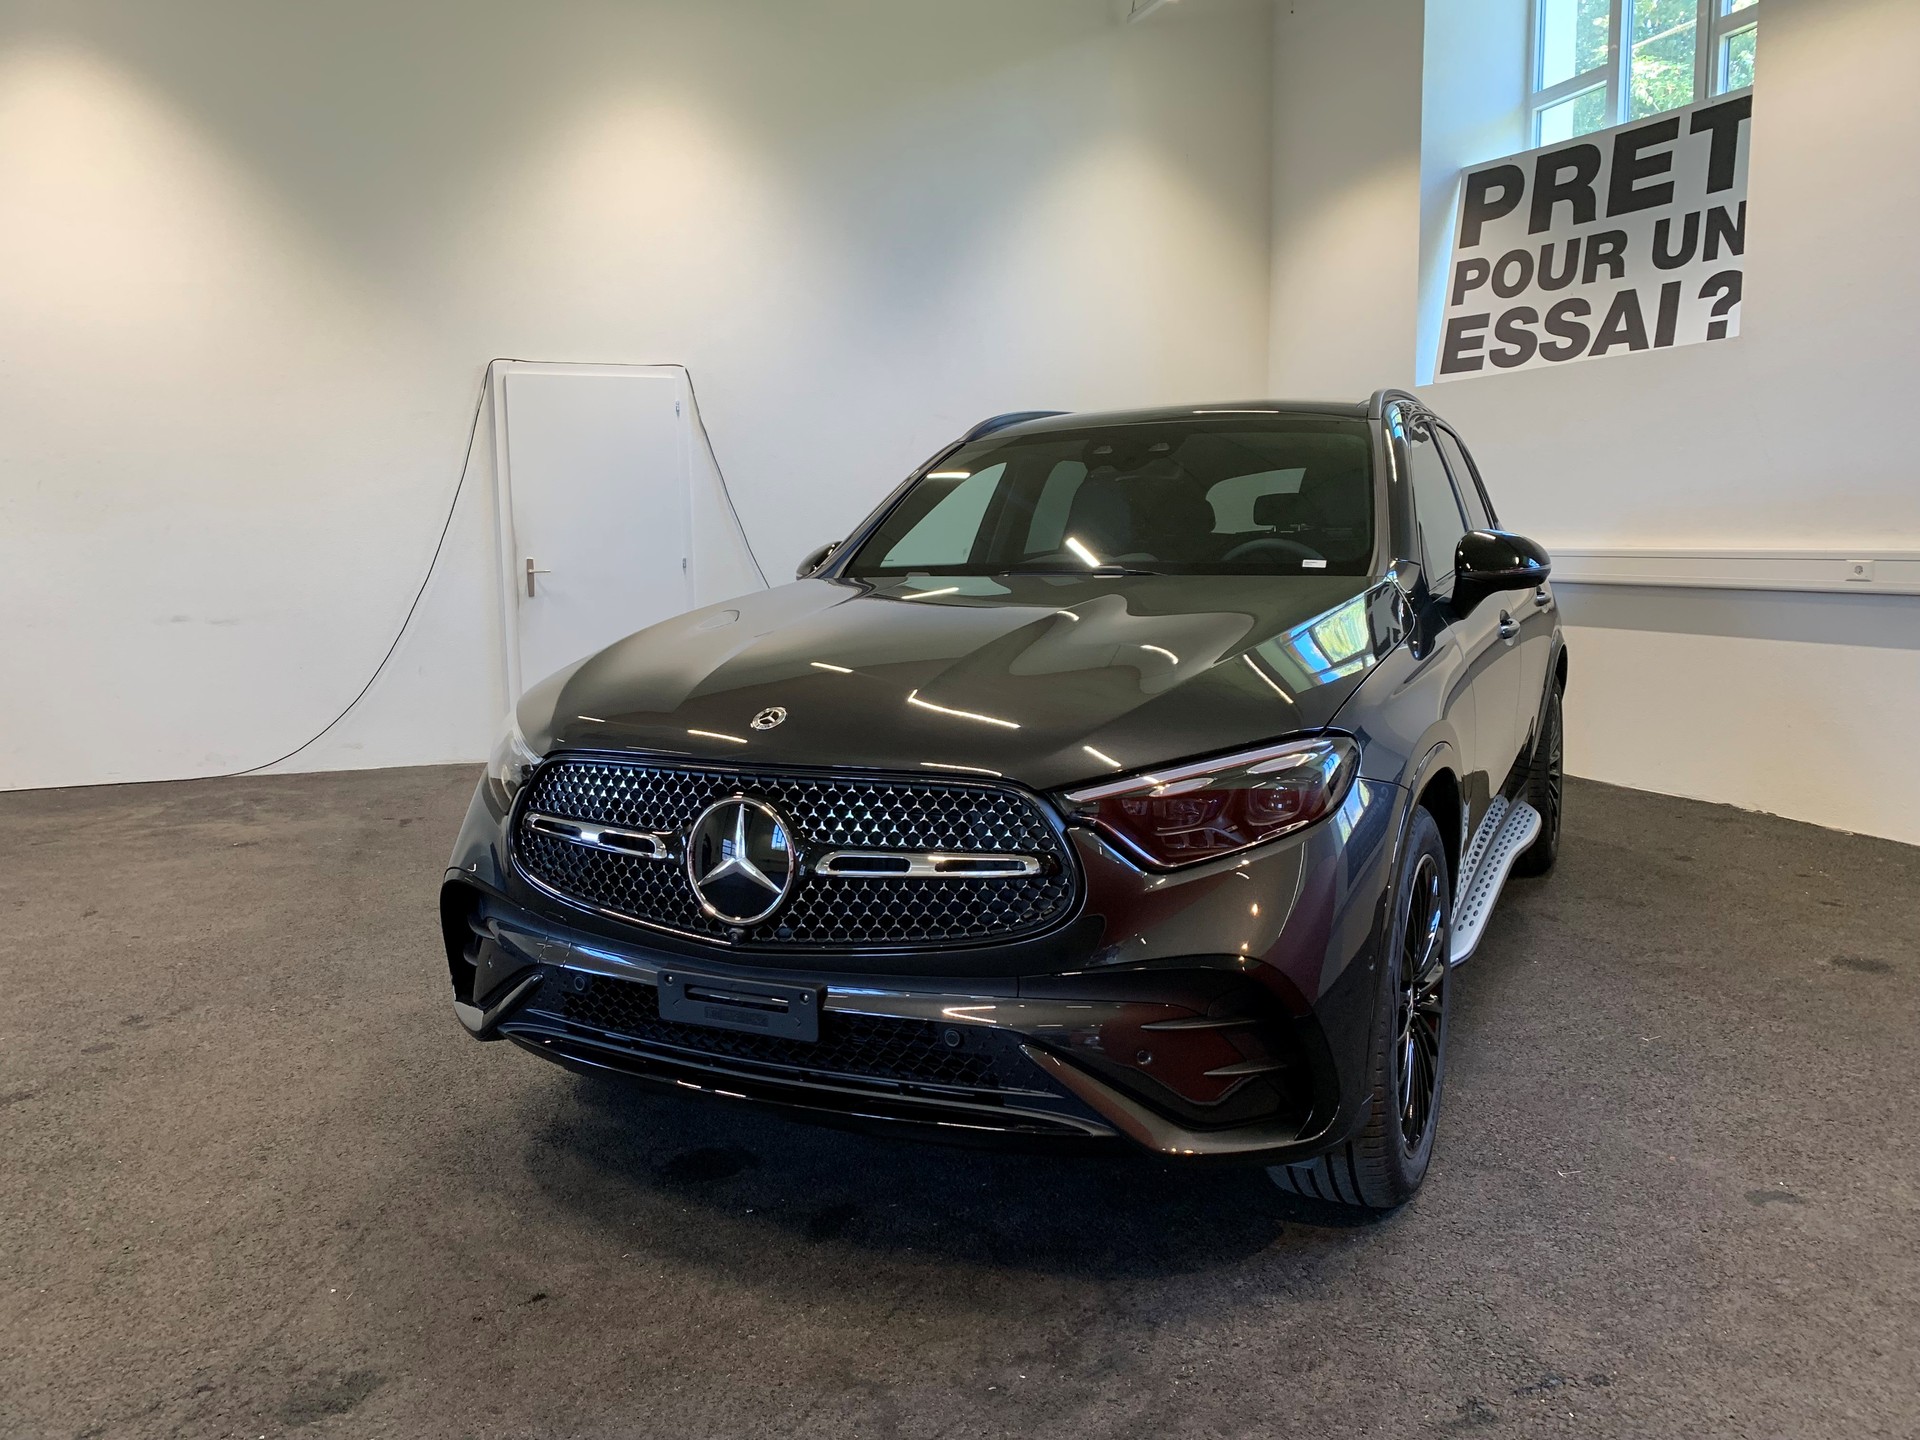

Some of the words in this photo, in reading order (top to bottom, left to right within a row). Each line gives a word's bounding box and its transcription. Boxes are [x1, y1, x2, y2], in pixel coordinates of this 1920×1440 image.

[1458, 94, 1753, 249] PRET
[1451, 229, 1628, 306] POUR
[1652, 200, 1747, 270] UN
[1440, 280, 1682, 374] ESSAI
[1698, 269, 1743, 341] ?
